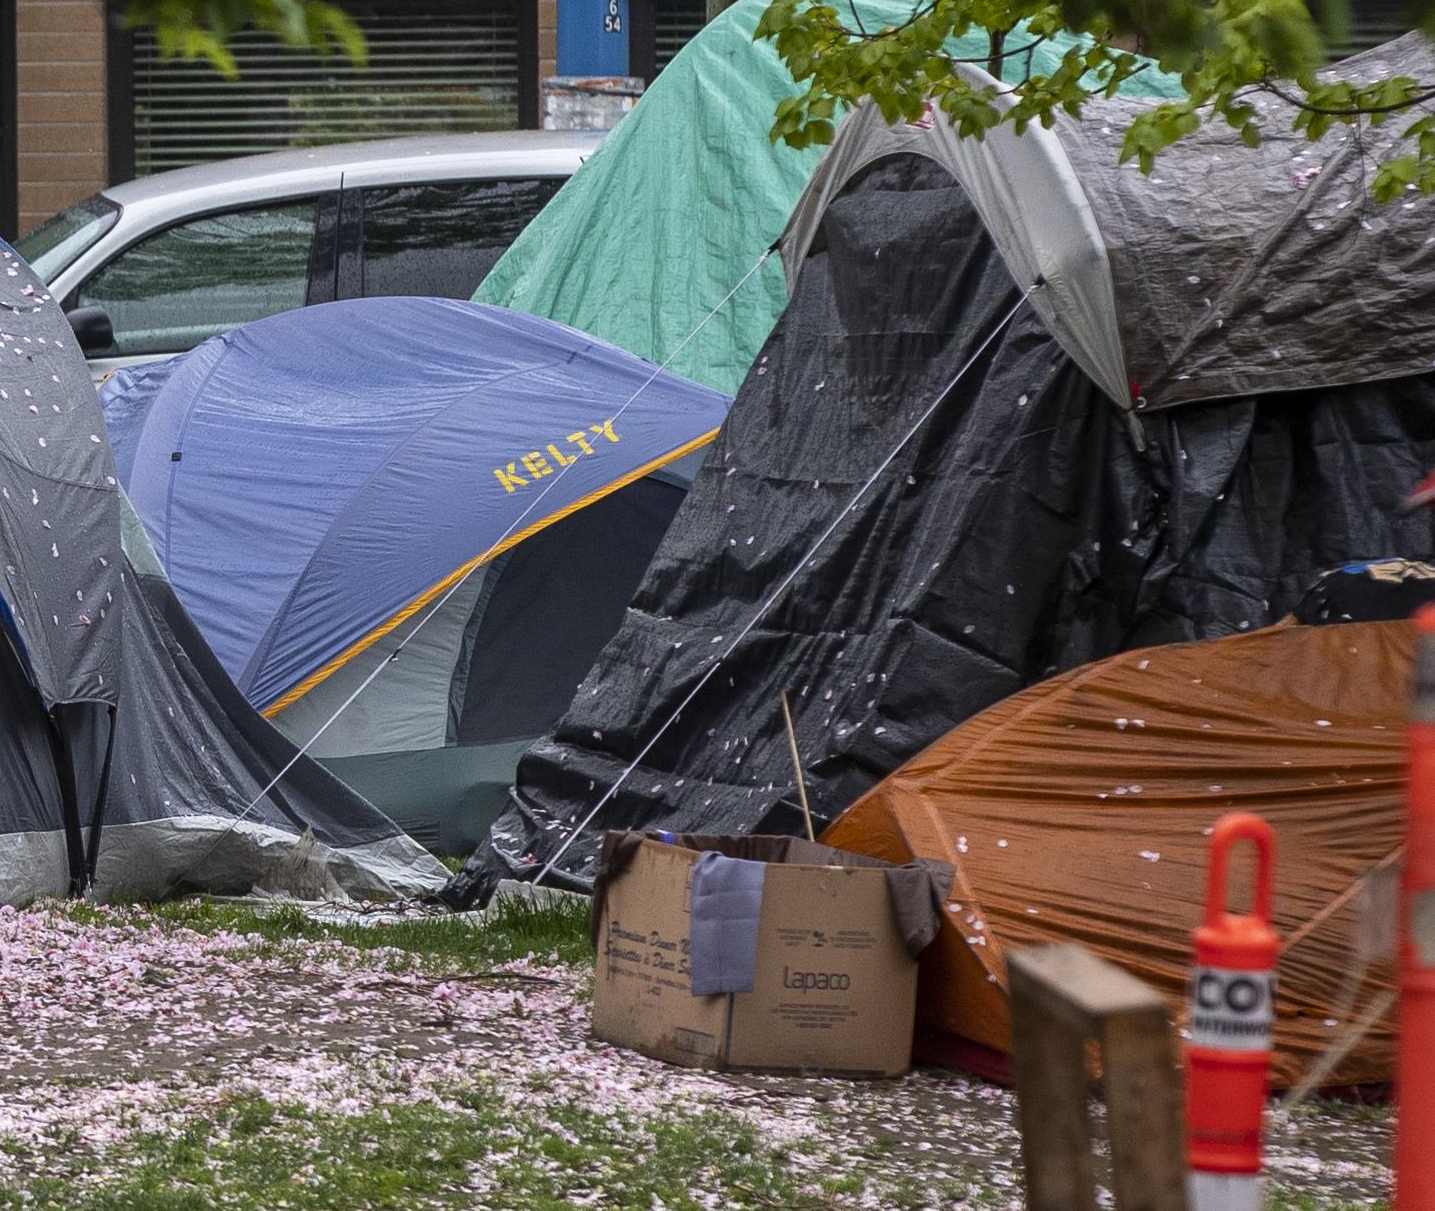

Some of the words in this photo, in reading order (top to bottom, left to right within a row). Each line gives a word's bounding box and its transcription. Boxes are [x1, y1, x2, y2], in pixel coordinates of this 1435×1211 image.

[605, 15, 621, 32] 54
[493, 419, 620, 493] KELTY
[784, 966, 850, 995] Lapaco
